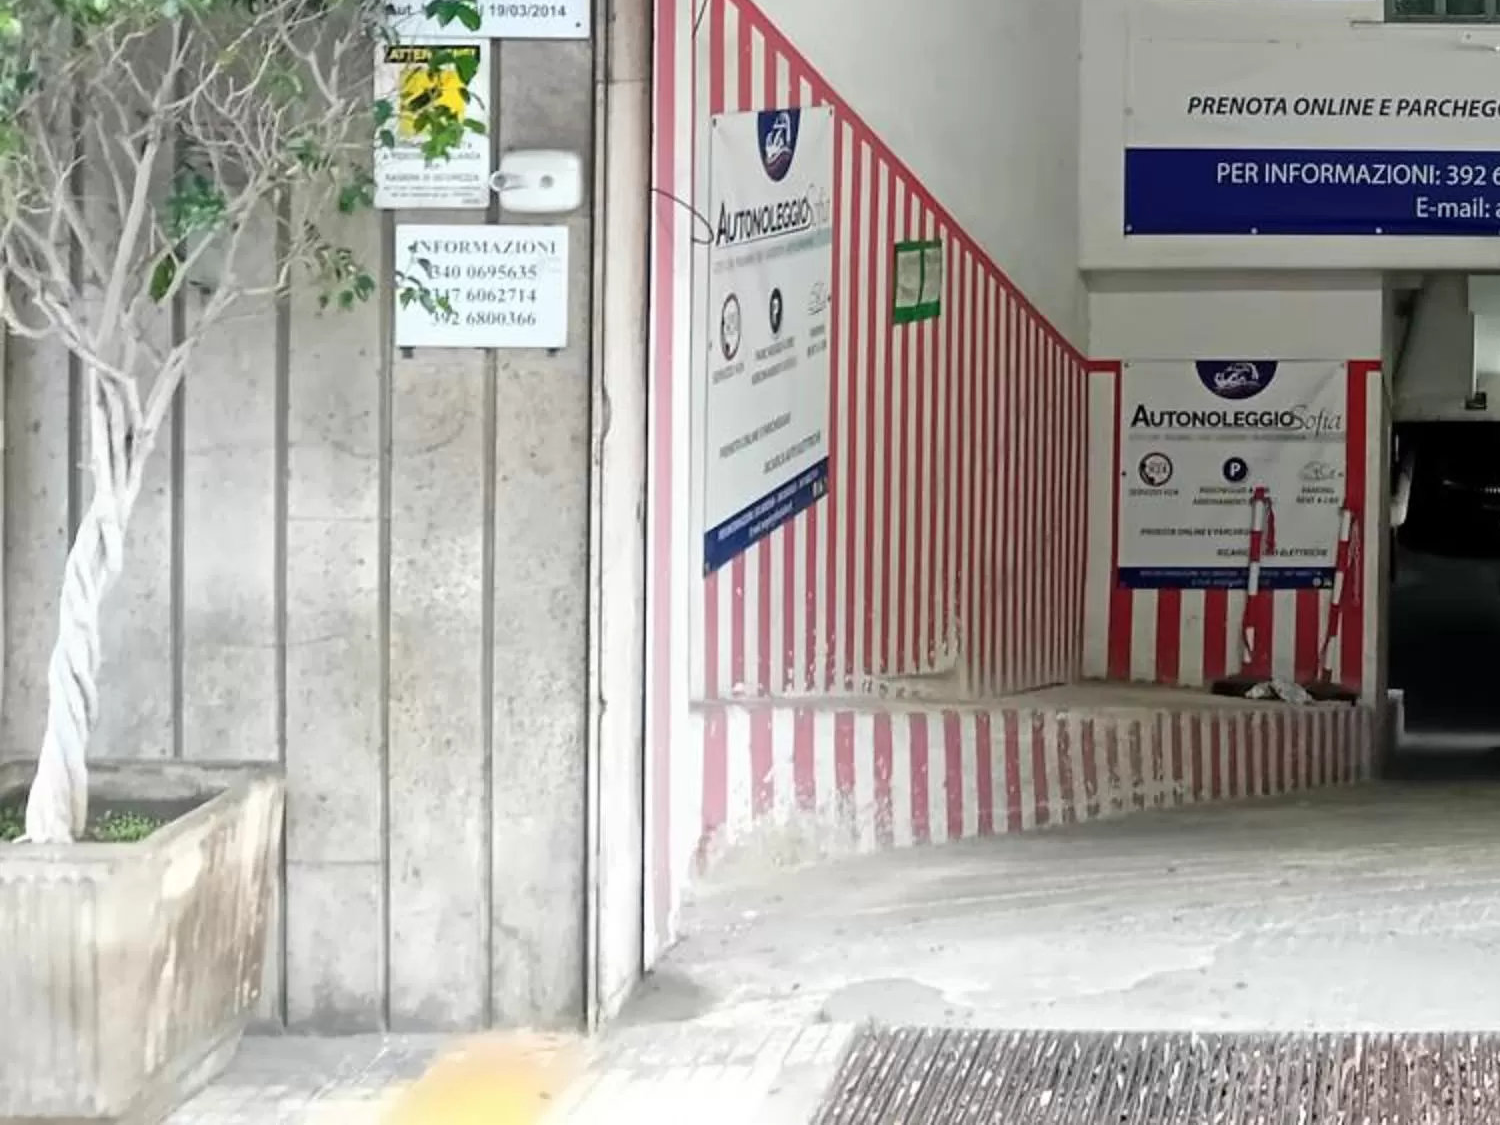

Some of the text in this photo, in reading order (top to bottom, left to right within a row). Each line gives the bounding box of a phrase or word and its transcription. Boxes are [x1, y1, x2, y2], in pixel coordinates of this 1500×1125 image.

[489, 3, 567, 17] 19/03/2014
[1187, 95, 1287, 116] PRENOTA
[1293, 96, 1375, 117] ONLINE
[1379, 98, 1392, 116] E
[1216, 163, 1260, 184] PER
[1265, 163, 1441, 186] INFORMAZIONI:
[1445, 166, 1487, 186] 392
[1415, 196, 1491, 219] E-mail:
[466, 263, 538, 280] 0695635
[466, 287, 537, 304] 6062714
[466, 310, 537, 326] 6800366
[1131, 404, 1294, 428] AUTONOLEGGIO
[1229, 462, 1241, 477] P
